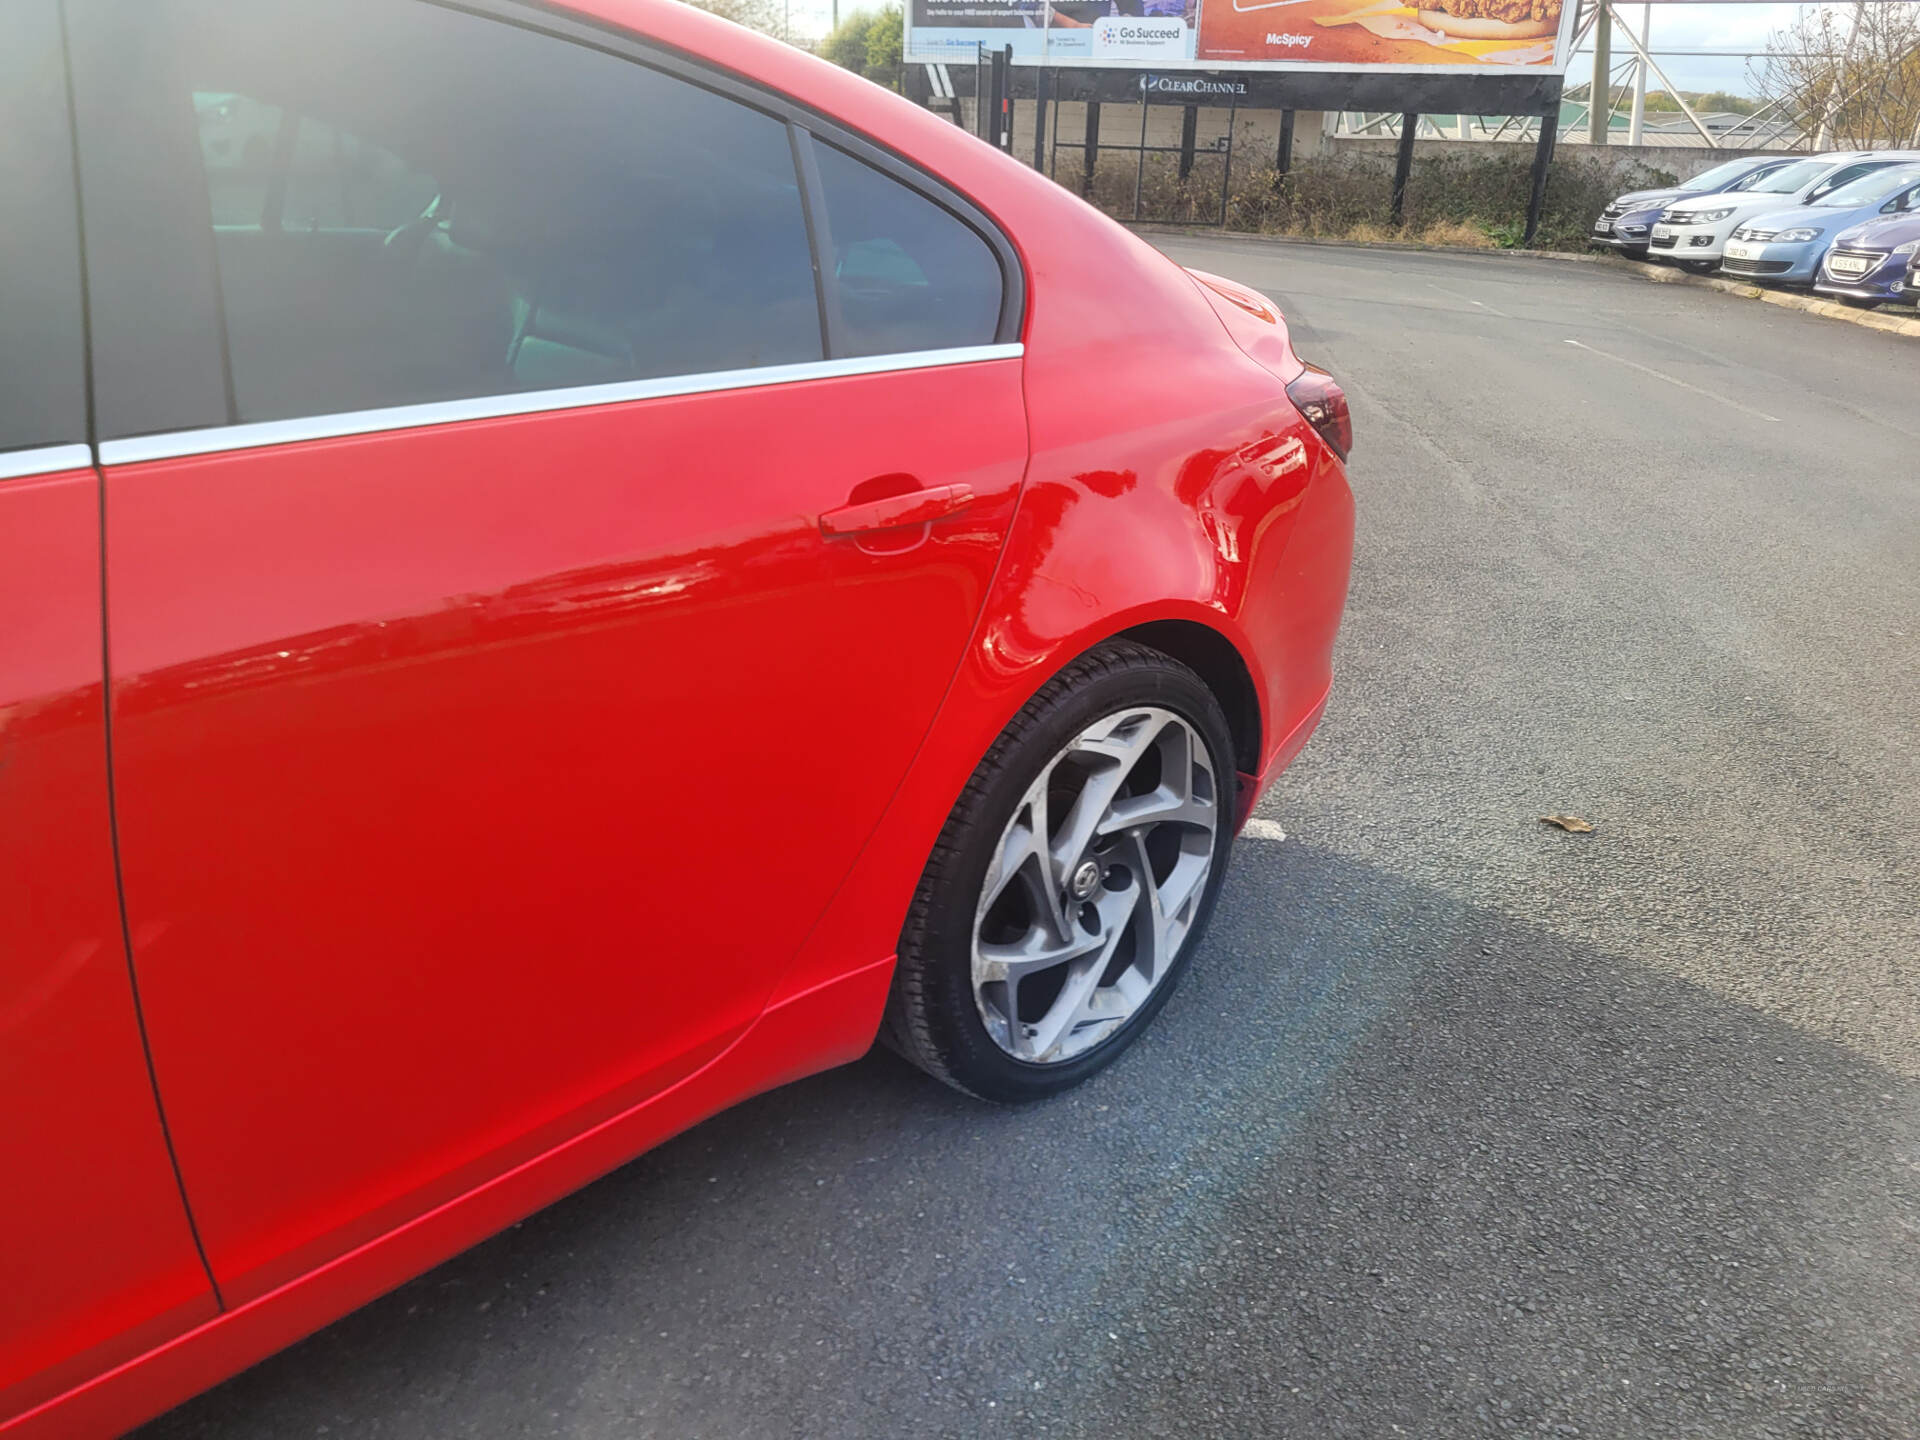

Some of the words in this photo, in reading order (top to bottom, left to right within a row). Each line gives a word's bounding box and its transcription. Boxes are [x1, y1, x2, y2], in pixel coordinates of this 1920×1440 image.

[1119, 28, 1135, 39] Go
[1137, 27, 1180, 39] Succeed
[1266, 33, 1312, 48] McSpicy
